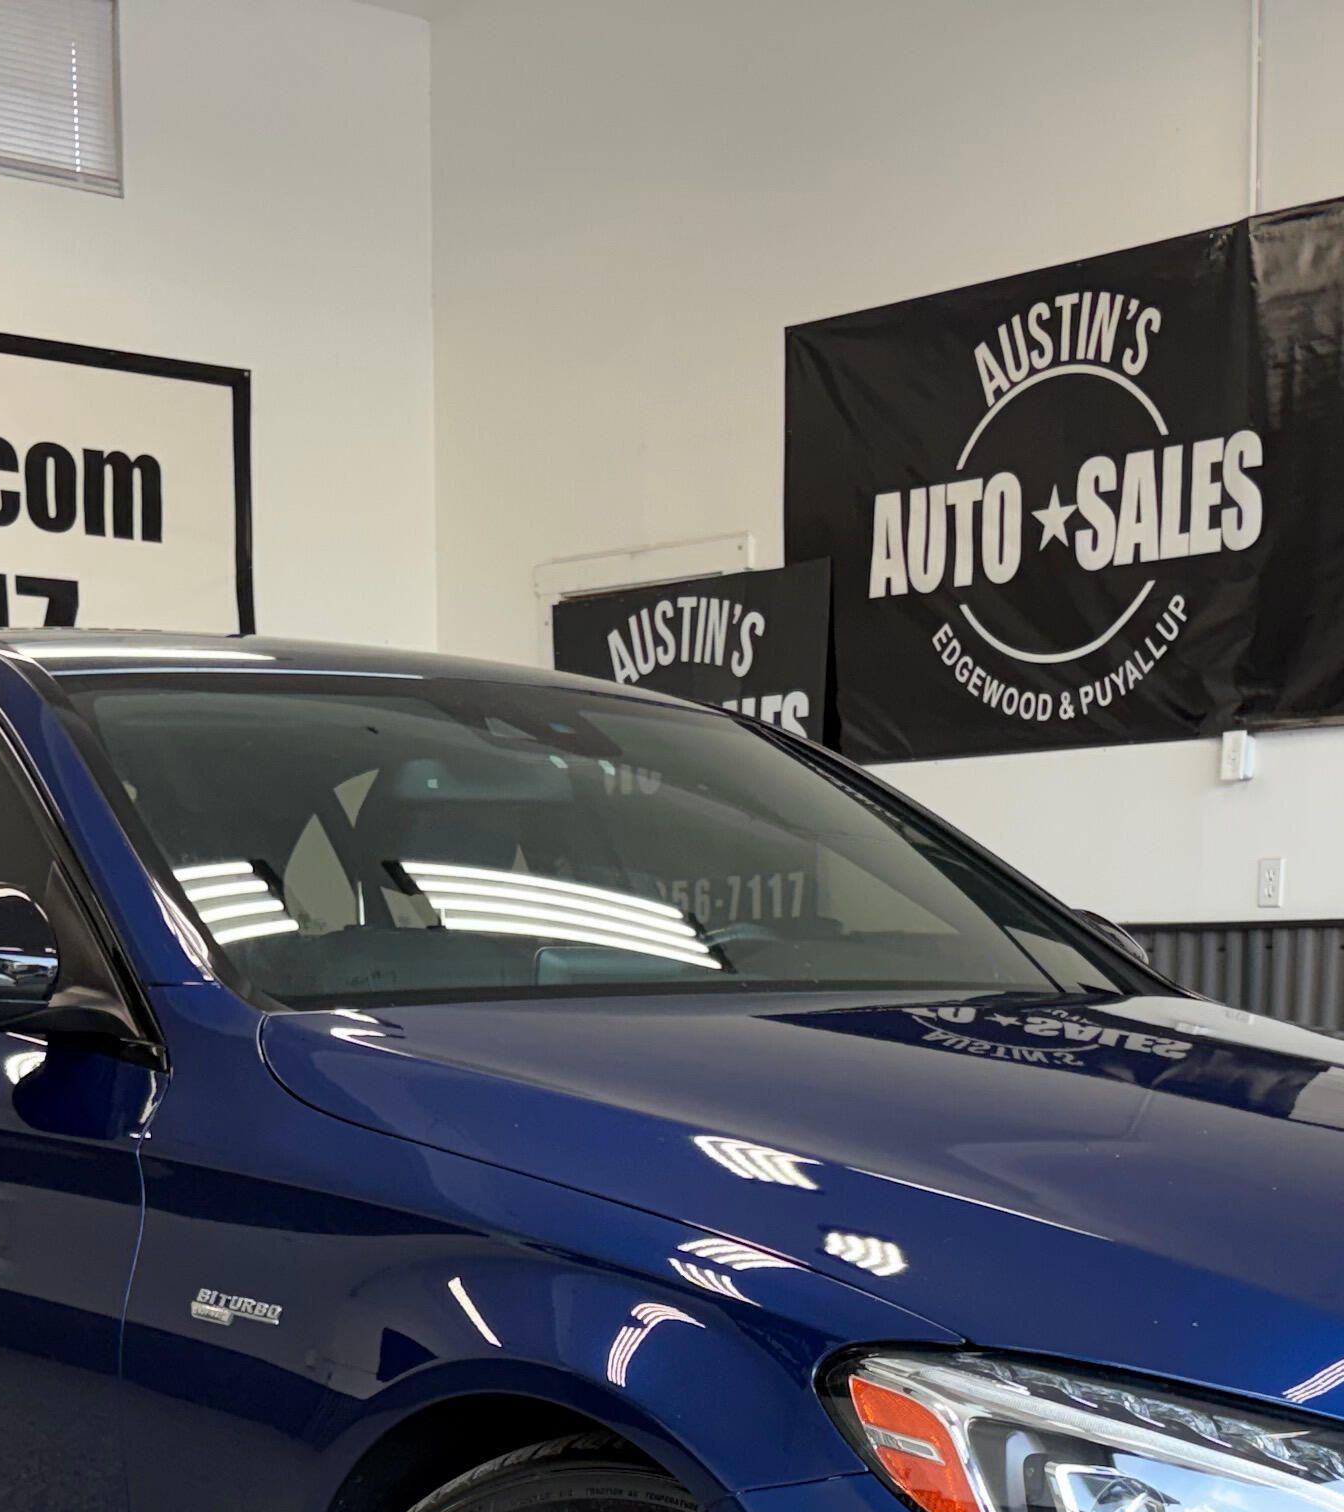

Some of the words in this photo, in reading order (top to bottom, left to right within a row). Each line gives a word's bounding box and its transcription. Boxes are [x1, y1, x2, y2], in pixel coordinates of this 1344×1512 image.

[974, 291, 1162, 406] AUSTIN'S
[869, 471, 1023, 599] AUTO
[1074, 429, 1264, 572] SALES
[607, 596, 766, 684] AUSTIN'S
[931, 622, 1053, 722] EDGEWOOD
[1058, 691, 1075, 721] &
[1078, 594, 1188, 715] PUYALLUP
[196, 1287, 283, 1320] BITURBO
